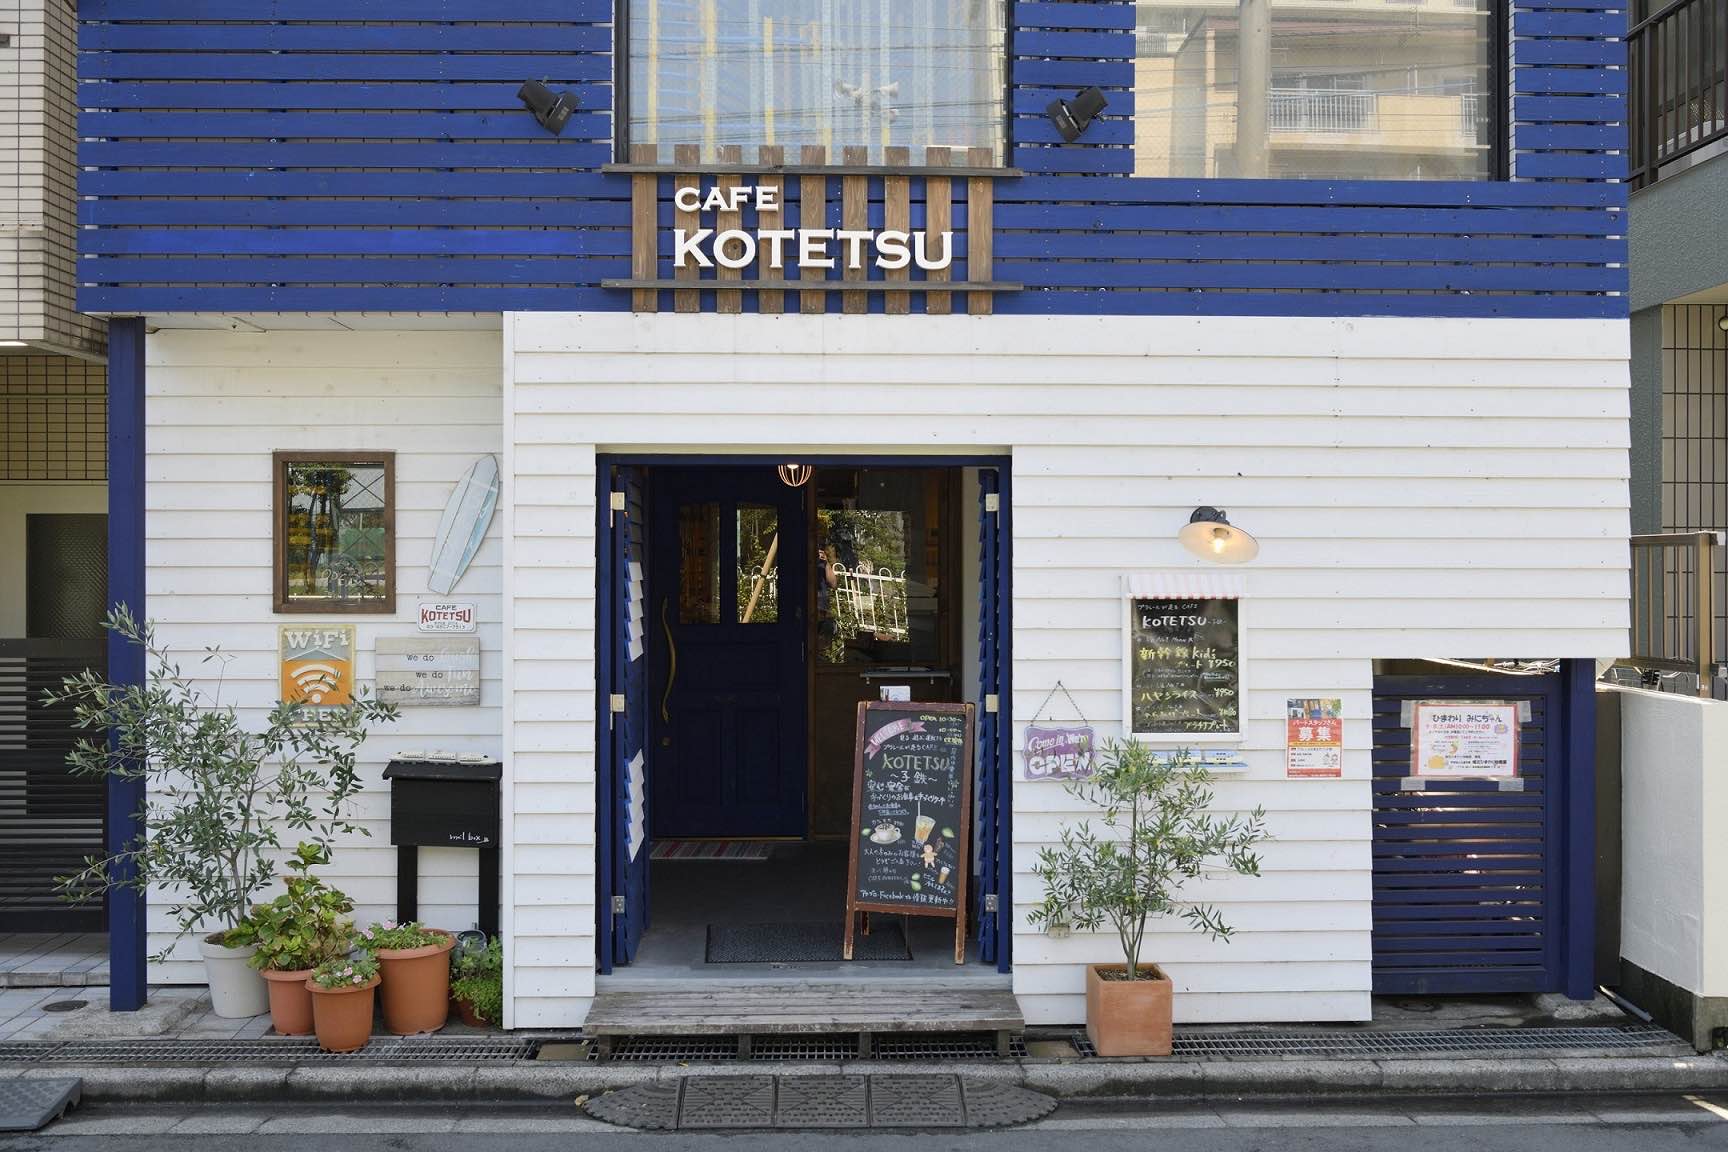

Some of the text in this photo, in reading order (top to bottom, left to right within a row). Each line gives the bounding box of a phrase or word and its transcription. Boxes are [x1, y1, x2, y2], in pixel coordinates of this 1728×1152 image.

[674, 185, 779, 213] CAFE
[673, 228, 953, 271] KOTETSU
[421, 608, 471, 625] KOTETSU
[285, 629, 349, 650] WiFi
[422, 653, 435, 662] do
[415, 671, 428, 679] we
[431, 670, 444, 679] do
[383, 684, 396, 692] we
[399, 683, 412, 692] do
[1140, 689, 1199, 701] ハヤシライス
[1432, 714, 1462, 723] ひまわり
[1298, 726, 1332, 742] 募集
[1028, 736, 1055, 752] Come
[881, 753, 950, 772] KOTETSU
[1029, 752, 1091, 775] OPEN
